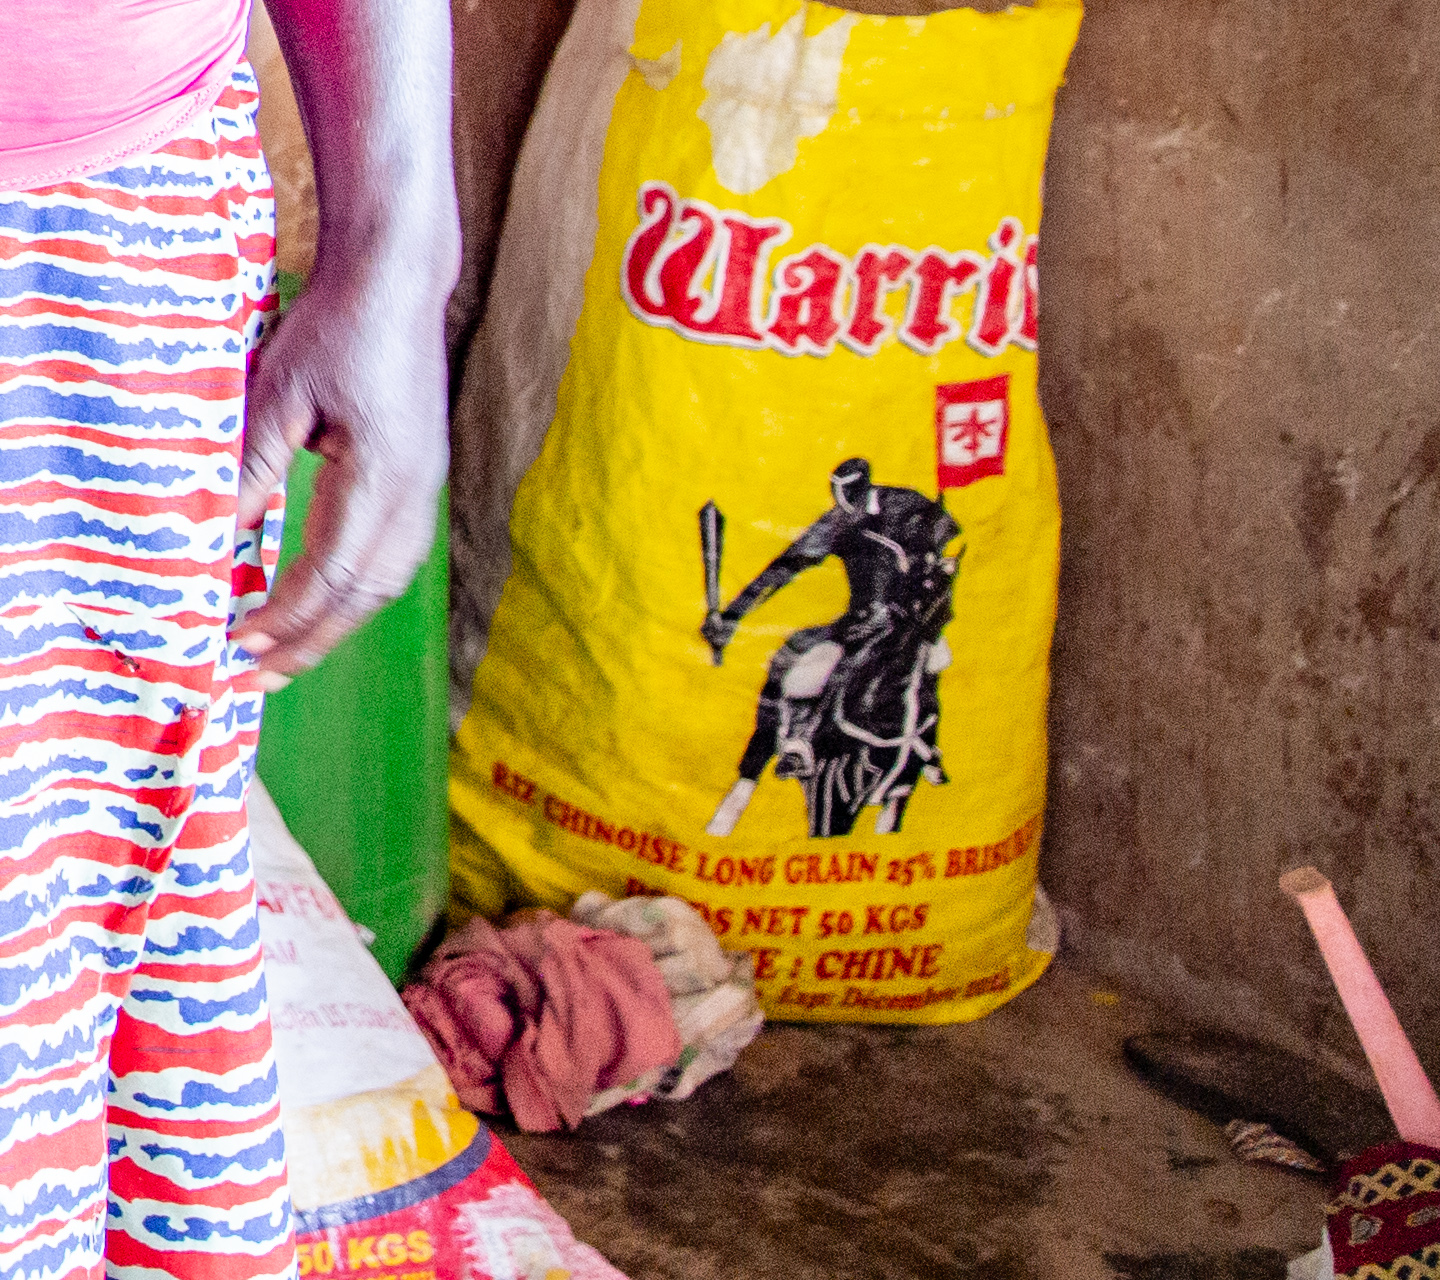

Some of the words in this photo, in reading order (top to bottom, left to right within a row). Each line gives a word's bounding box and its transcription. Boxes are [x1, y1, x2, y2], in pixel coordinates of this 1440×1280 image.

[543, 793, 686, 874] CHINOISE
[695, 851, 776, 886] LONG
[784, 851, 879, 885] GRAIN
[886, 851, 937, 887] 25%
[739, 905, 809, 936] NET
[818, 909, 855, 939] 50
[862, 902, 929, 937] KGS
[814, 942, 944, 981] CHINE
[347, 1229, 436, 1271] KGS
